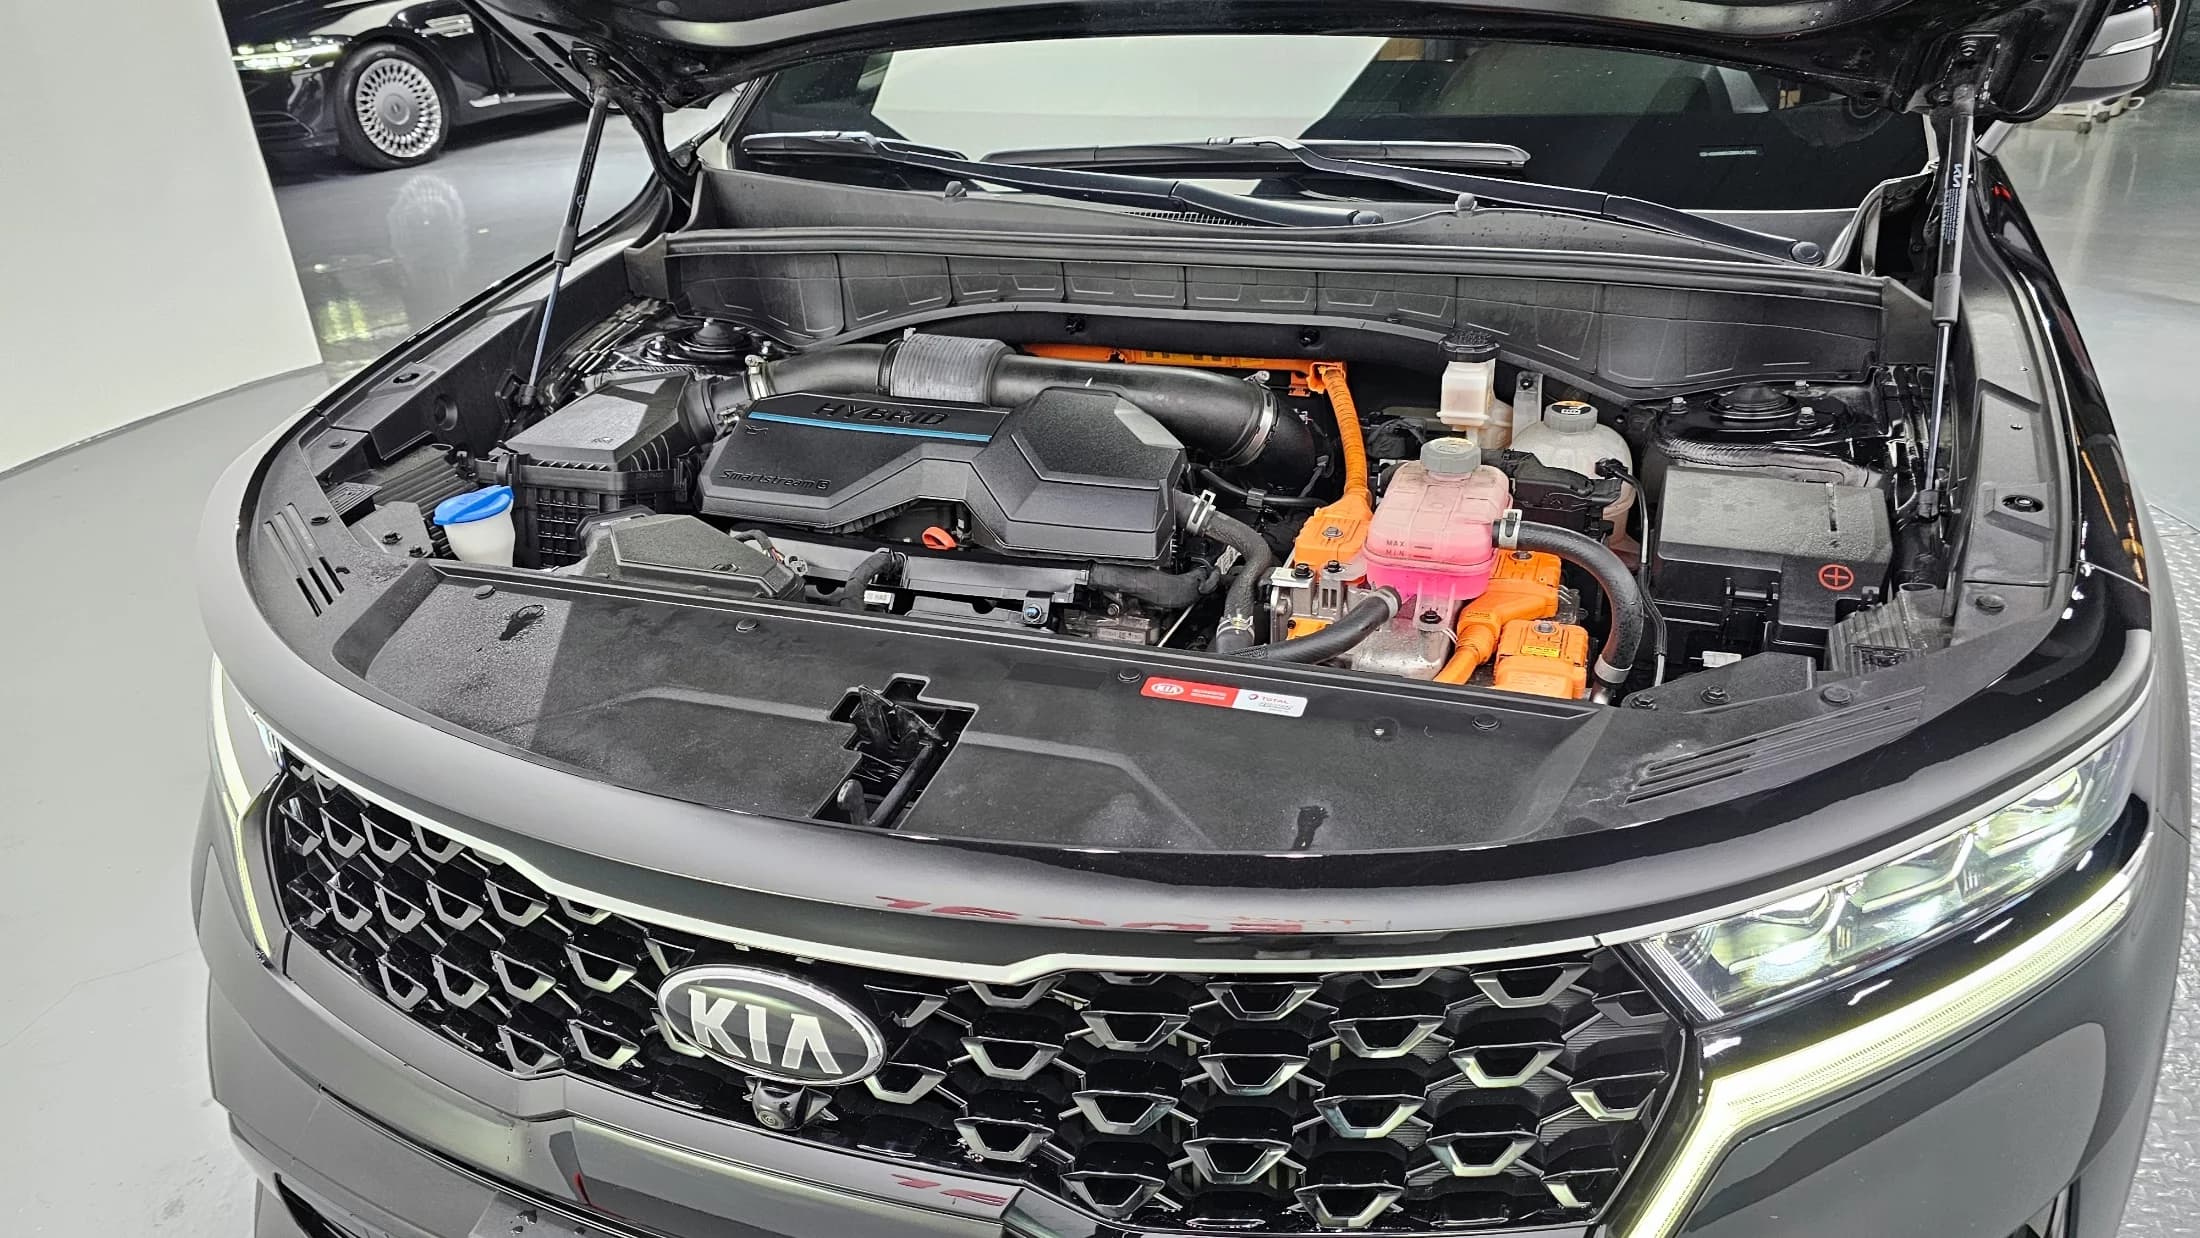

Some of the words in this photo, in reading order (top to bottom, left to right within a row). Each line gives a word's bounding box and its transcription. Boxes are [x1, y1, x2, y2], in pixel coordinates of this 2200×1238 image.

[812, 402, 949, 426] HYBRID
[719, 470, 816, 490] Smartstream
[1386, 539, 1405, 547] MAX
[1386, 549, 1405, 557] MIN
[1261, 696, 1289, 705] TOTAL
[688, 988, 843, 1075] KIA
